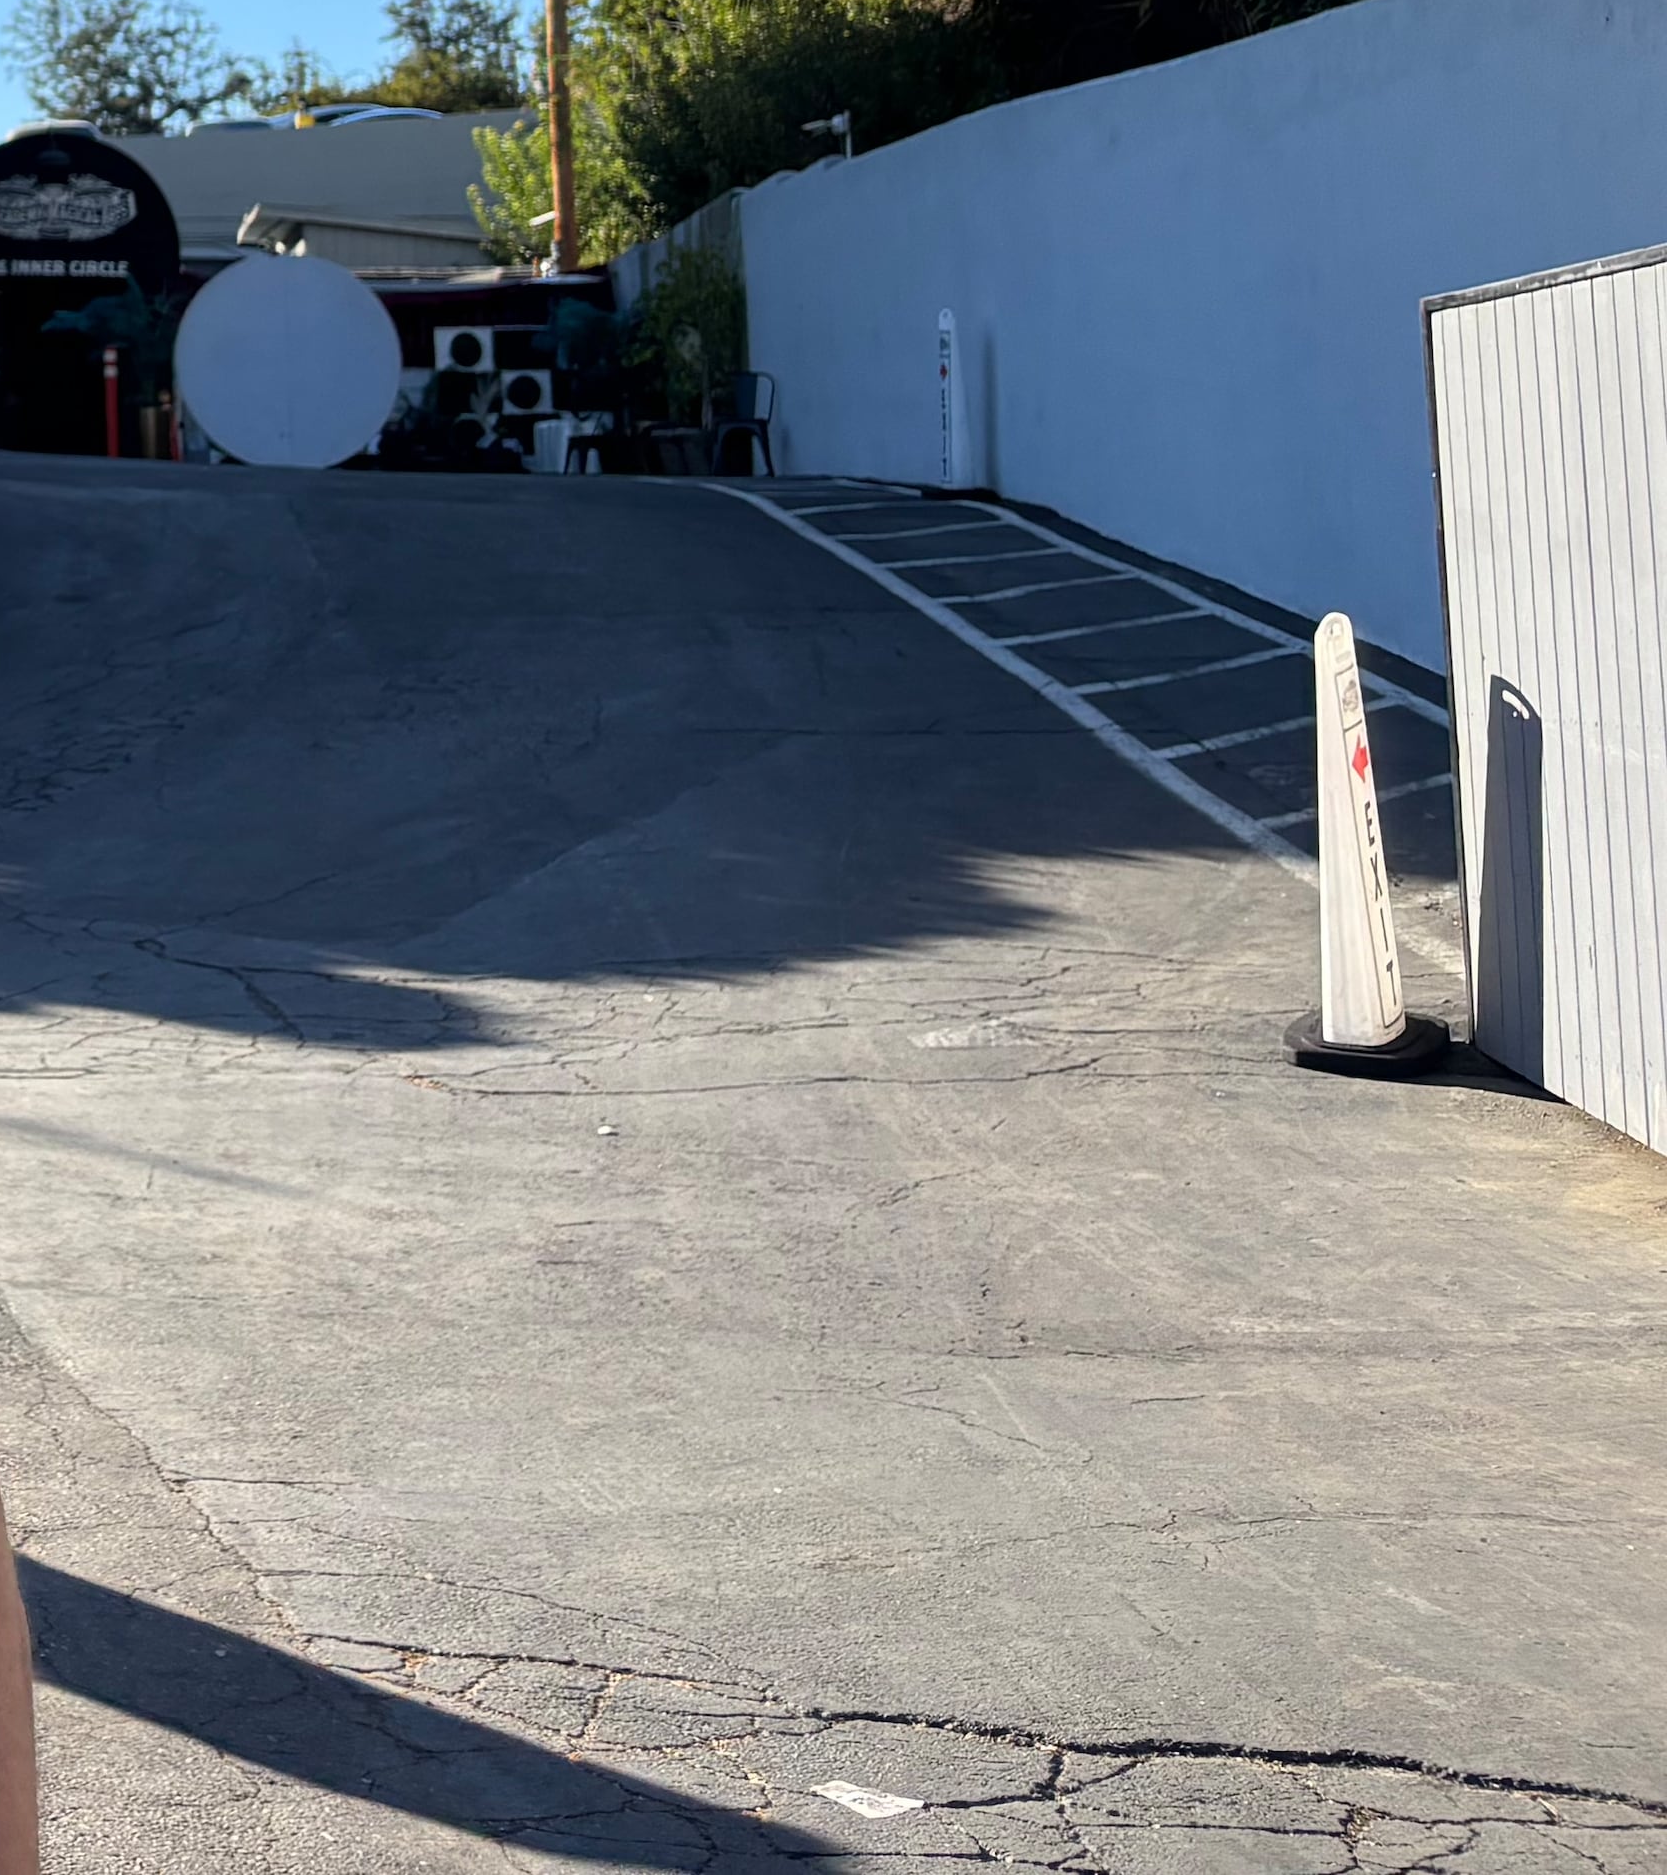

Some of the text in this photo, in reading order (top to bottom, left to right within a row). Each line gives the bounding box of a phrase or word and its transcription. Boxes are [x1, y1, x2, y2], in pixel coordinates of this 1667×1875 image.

[11, 259, 66, 276] INNER
[69, 260, 129, 277] CIRCLE
[1363, 800, 1397, 1007] EXIT
